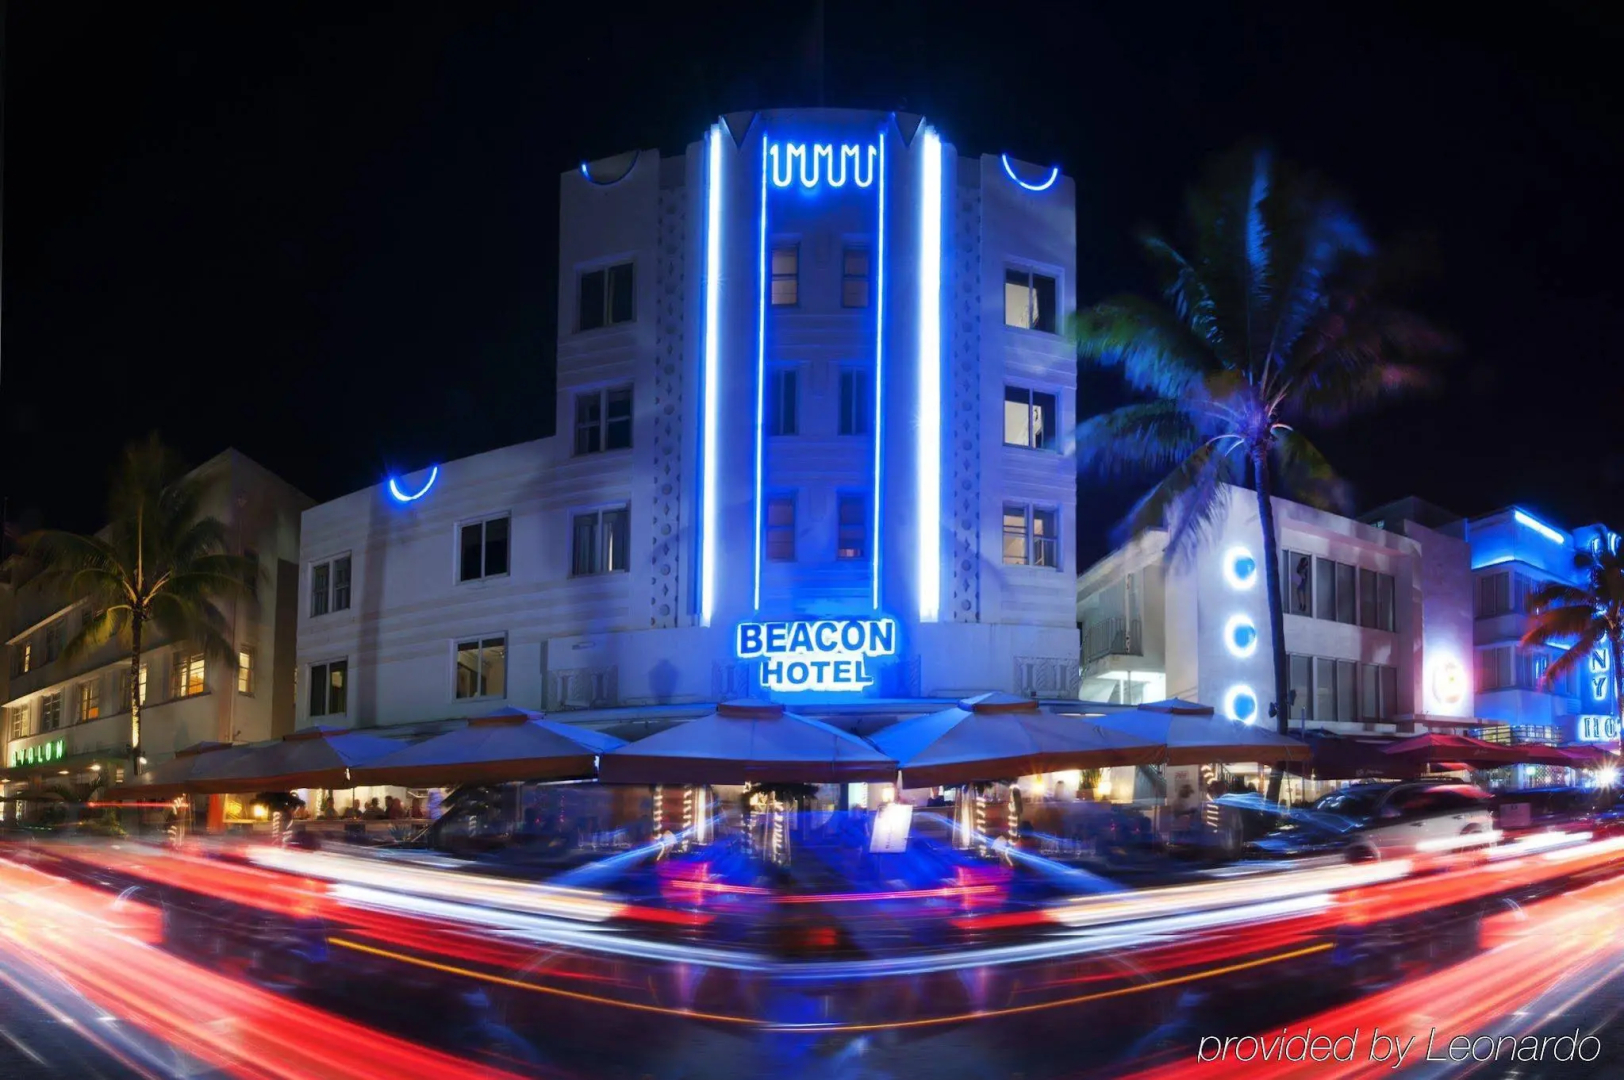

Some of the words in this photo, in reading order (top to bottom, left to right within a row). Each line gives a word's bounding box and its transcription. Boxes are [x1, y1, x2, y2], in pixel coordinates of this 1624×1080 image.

[739, 620, 894, 655] BEACON
[761, 659, 873, 685] HOTEL
[11, 739, 64, 768] AVALON
